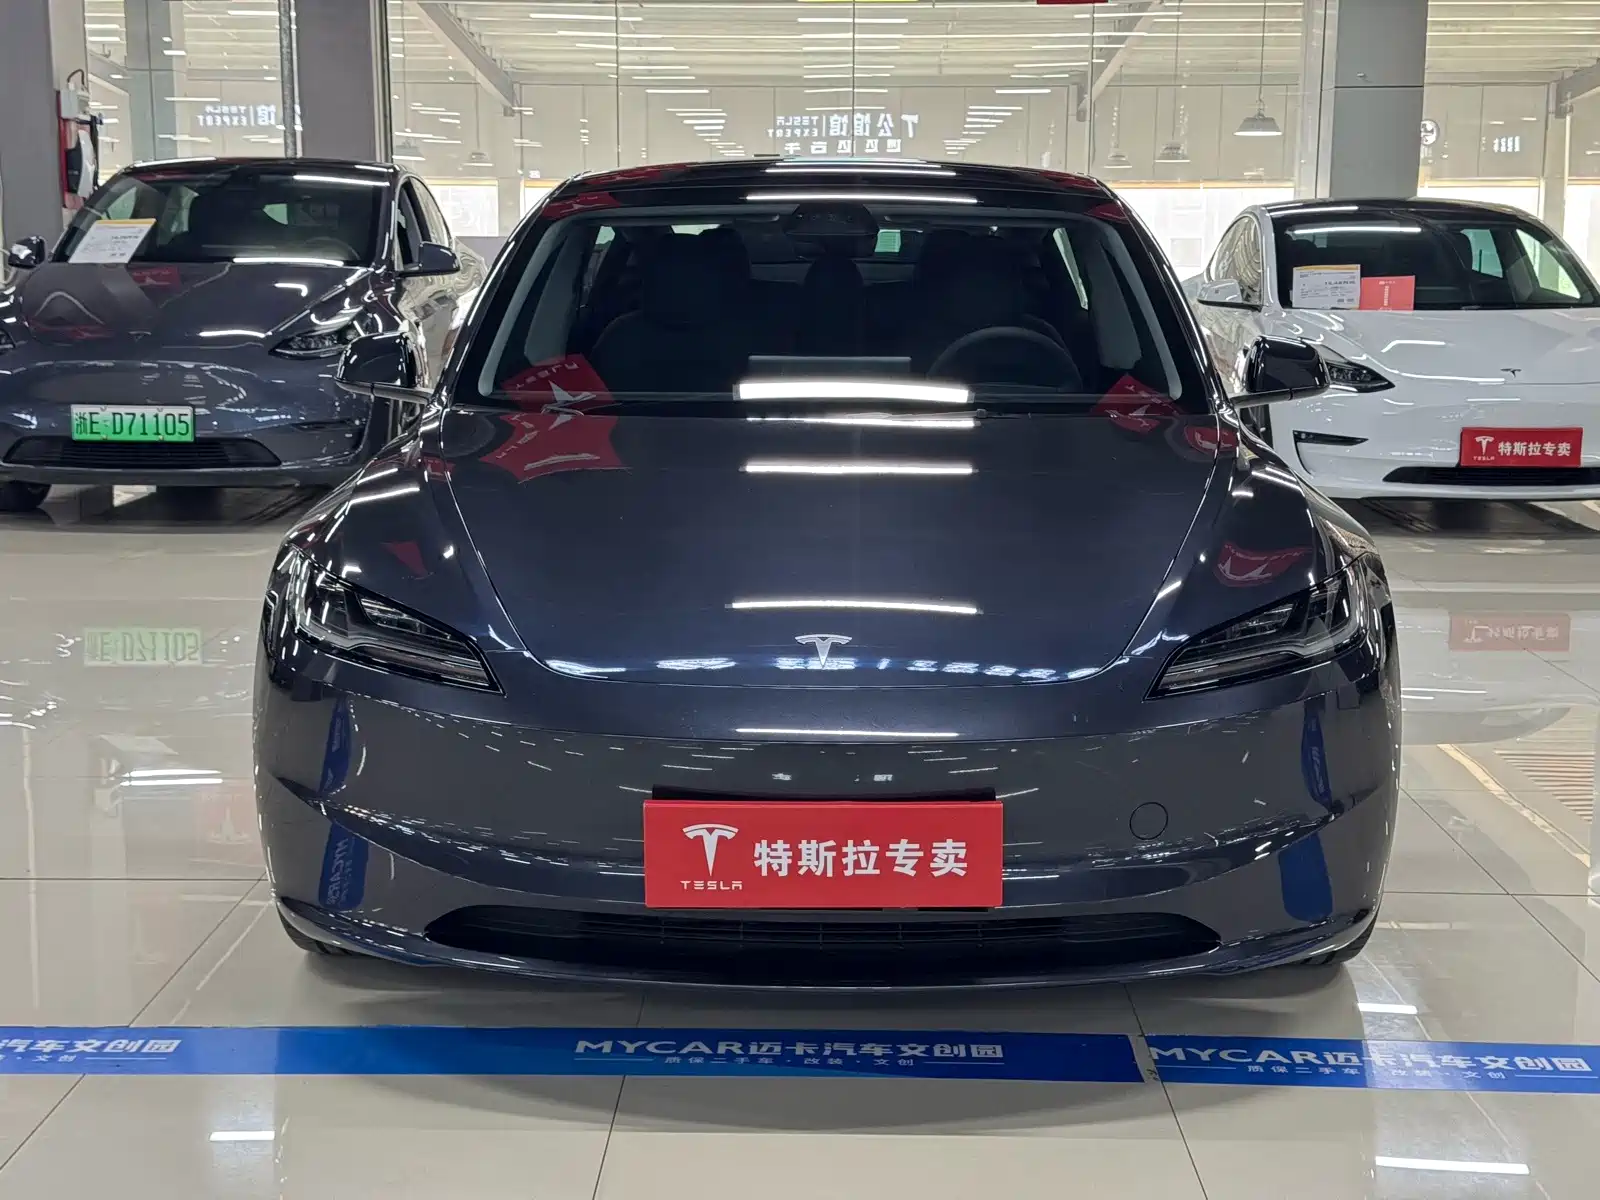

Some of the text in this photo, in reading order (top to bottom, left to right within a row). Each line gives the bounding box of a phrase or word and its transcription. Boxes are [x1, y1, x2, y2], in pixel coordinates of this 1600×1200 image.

[1498, 441, 1571, 457] 特斯拉专卖
[753, 838, 969, 878] 特斯拉专卖
[680, 880, 743, 891] TESLA
